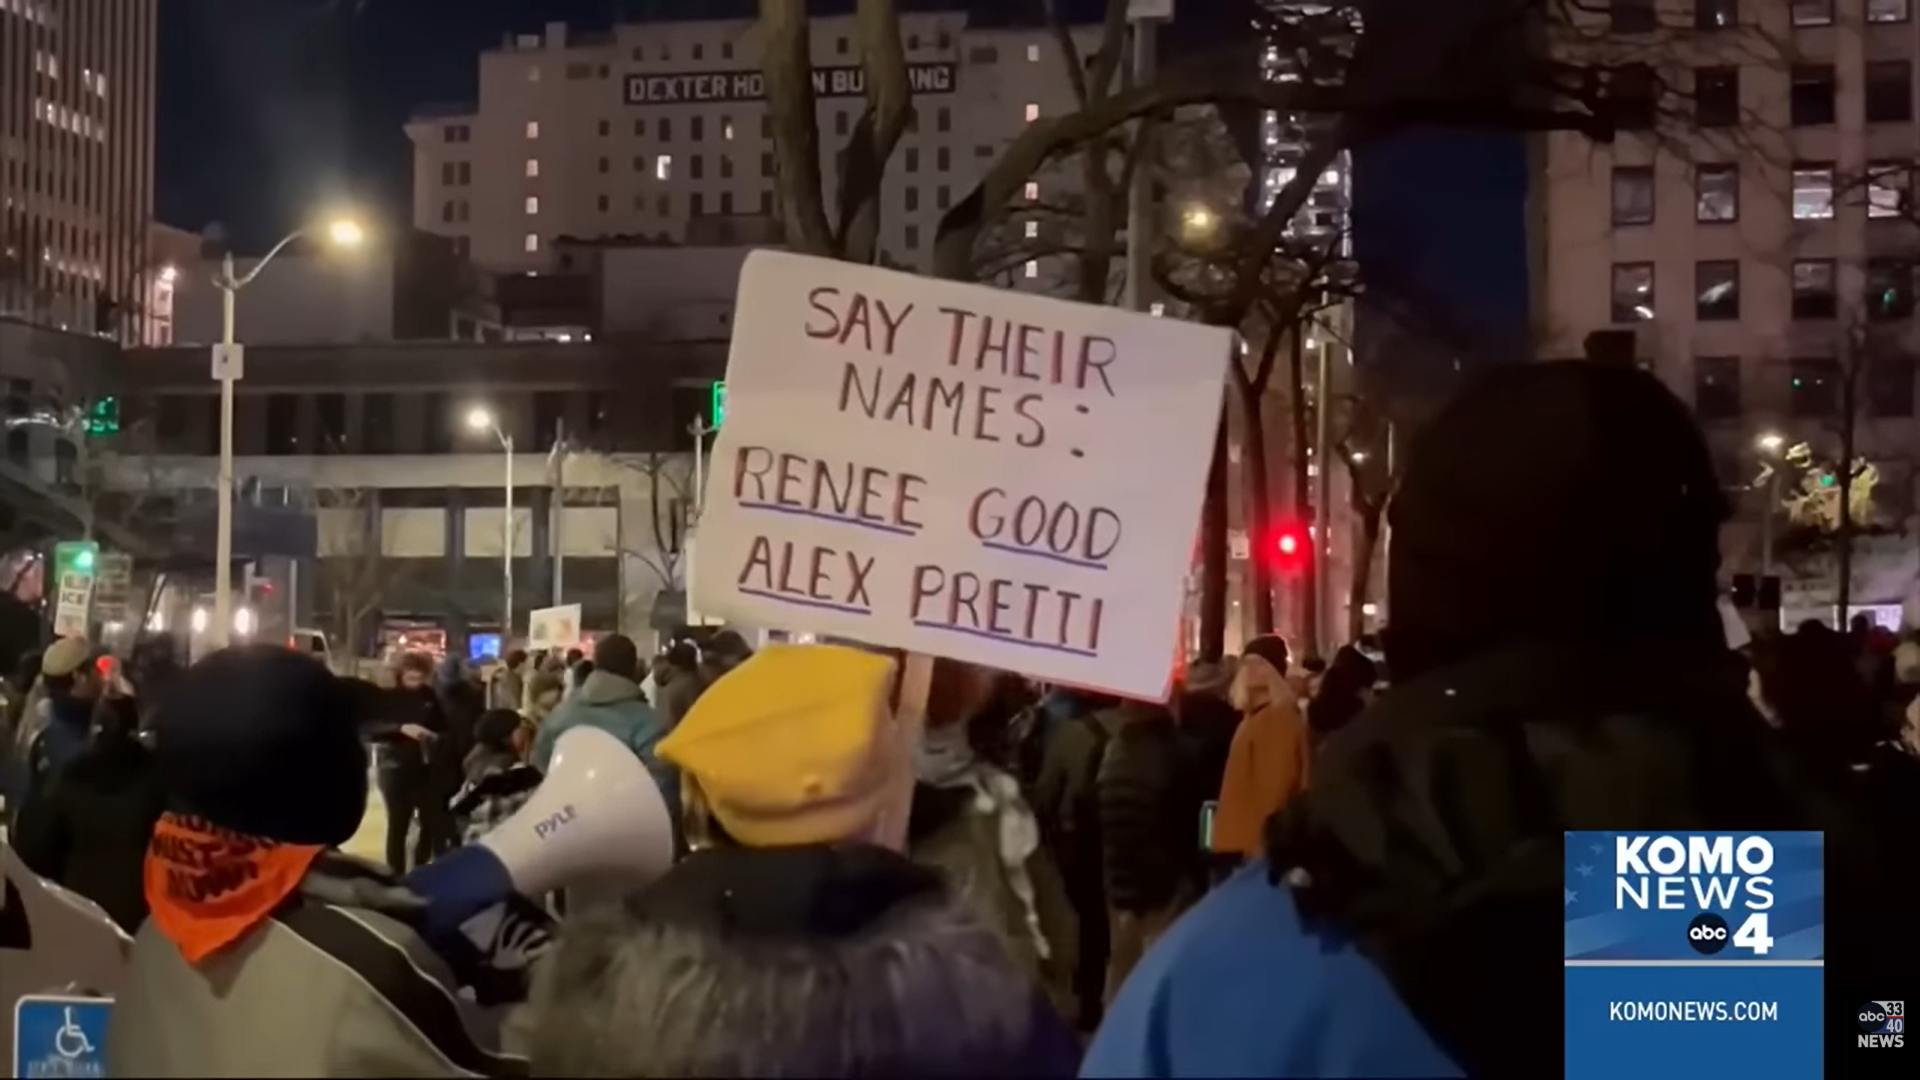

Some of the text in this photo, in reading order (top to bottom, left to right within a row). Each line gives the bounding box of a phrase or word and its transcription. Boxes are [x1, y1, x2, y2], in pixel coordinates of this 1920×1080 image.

[629, 75, 727, 101] DEXTER
[733, 71, 826, 97] HON
[804, 286, 1118, 397] SAY THEIR
[734, 446, 1122, 561] RENEE GOOD
[738, 536, 1104, 650] ALEX PRETTI
